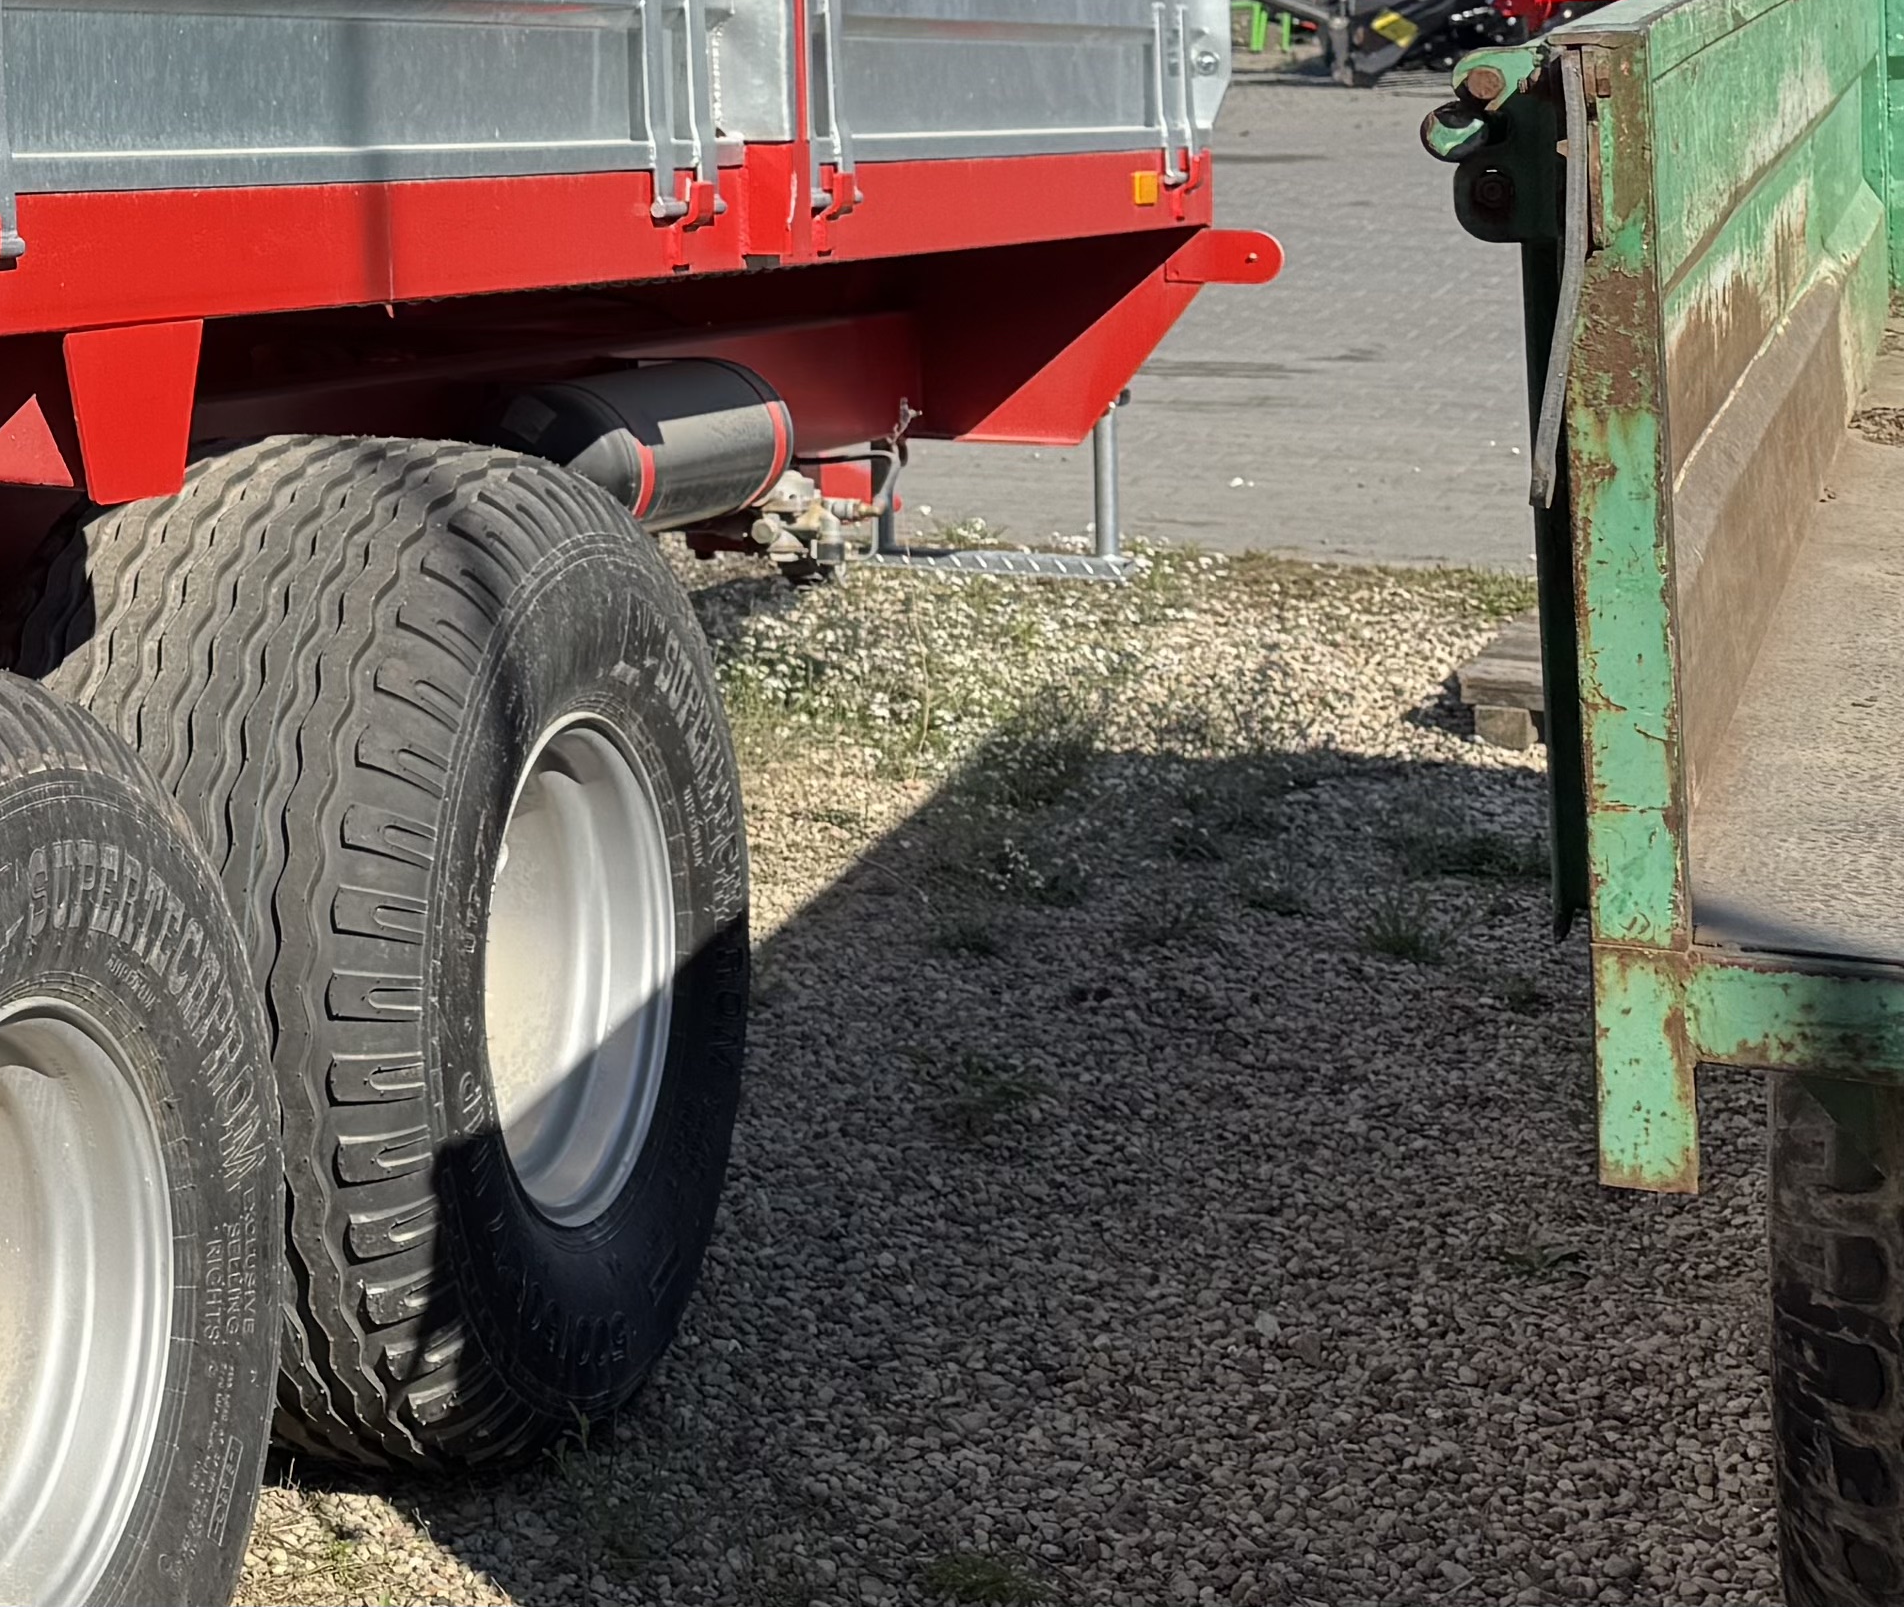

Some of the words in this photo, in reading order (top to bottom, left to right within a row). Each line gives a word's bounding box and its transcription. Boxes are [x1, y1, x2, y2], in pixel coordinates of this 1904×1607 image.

[203, 1238, 223, 1342] RIGHTS
[225, 1221, 241, 1336] SELLING
[242, 1184, 257, 1336] EXCLUSIVE
